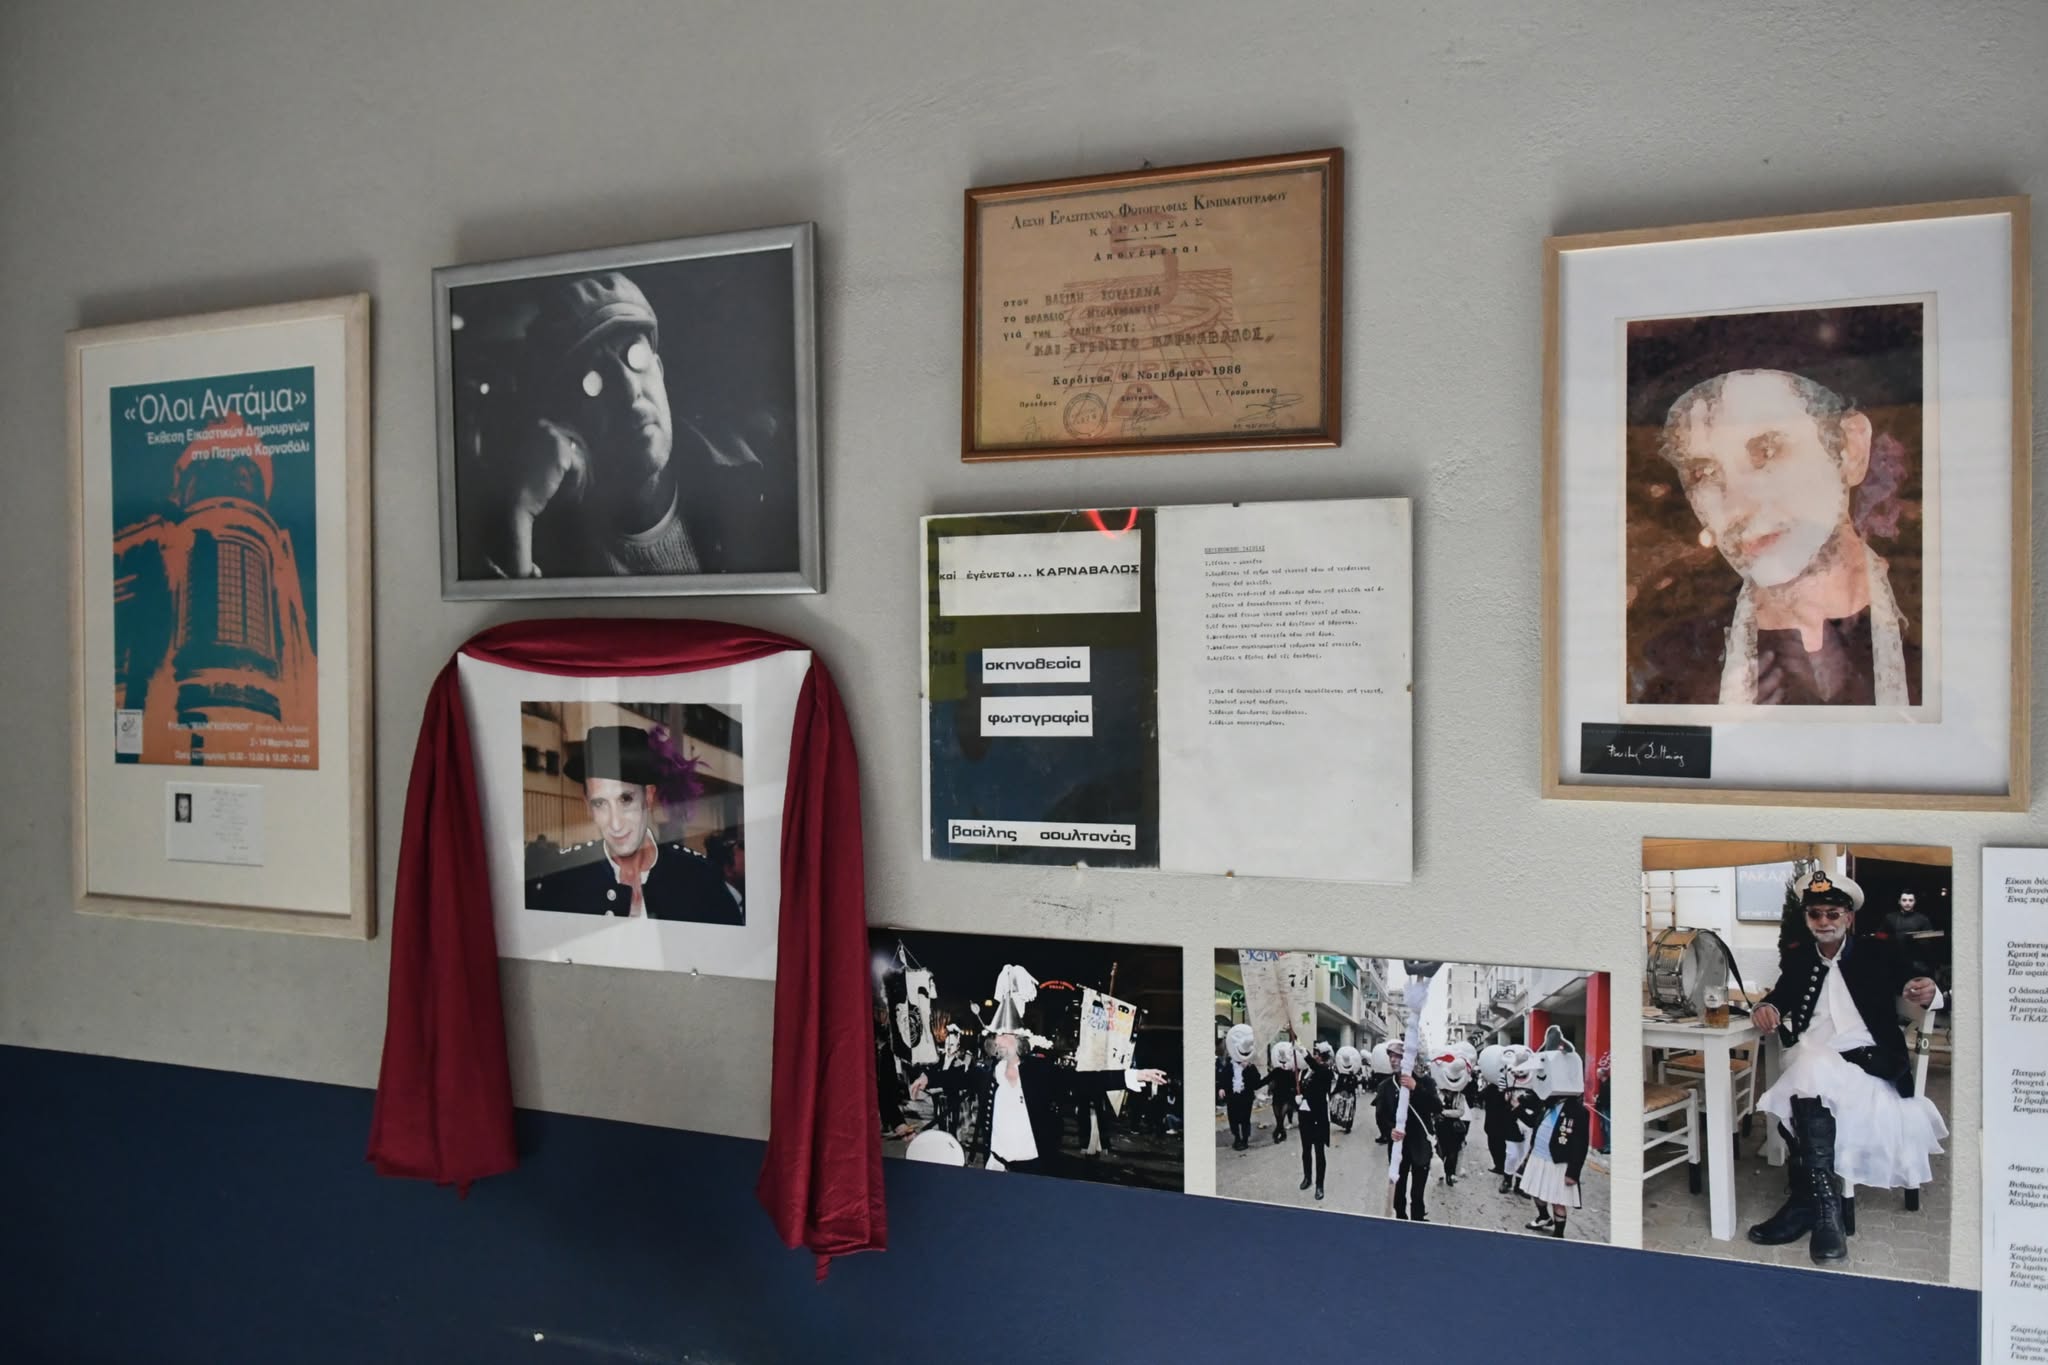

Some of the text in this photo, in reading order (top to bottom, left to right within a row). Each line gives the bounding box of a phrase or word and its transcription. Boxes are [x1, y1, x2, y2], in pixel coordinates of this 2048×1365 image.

[1212, 364, 1241, 376] 1986
[200, 383, 307, 420] Αντάμα»
[1036, 563, 1140, 577] ΚΑΡΝΑΒΑΛΟΣ
[985, 655, 1081, 671] σκηνοθεσία
[987, 711, 1090, 726] φωτογραφία
[951, 824, 1132, 847] βασίλης σουλτανάς
